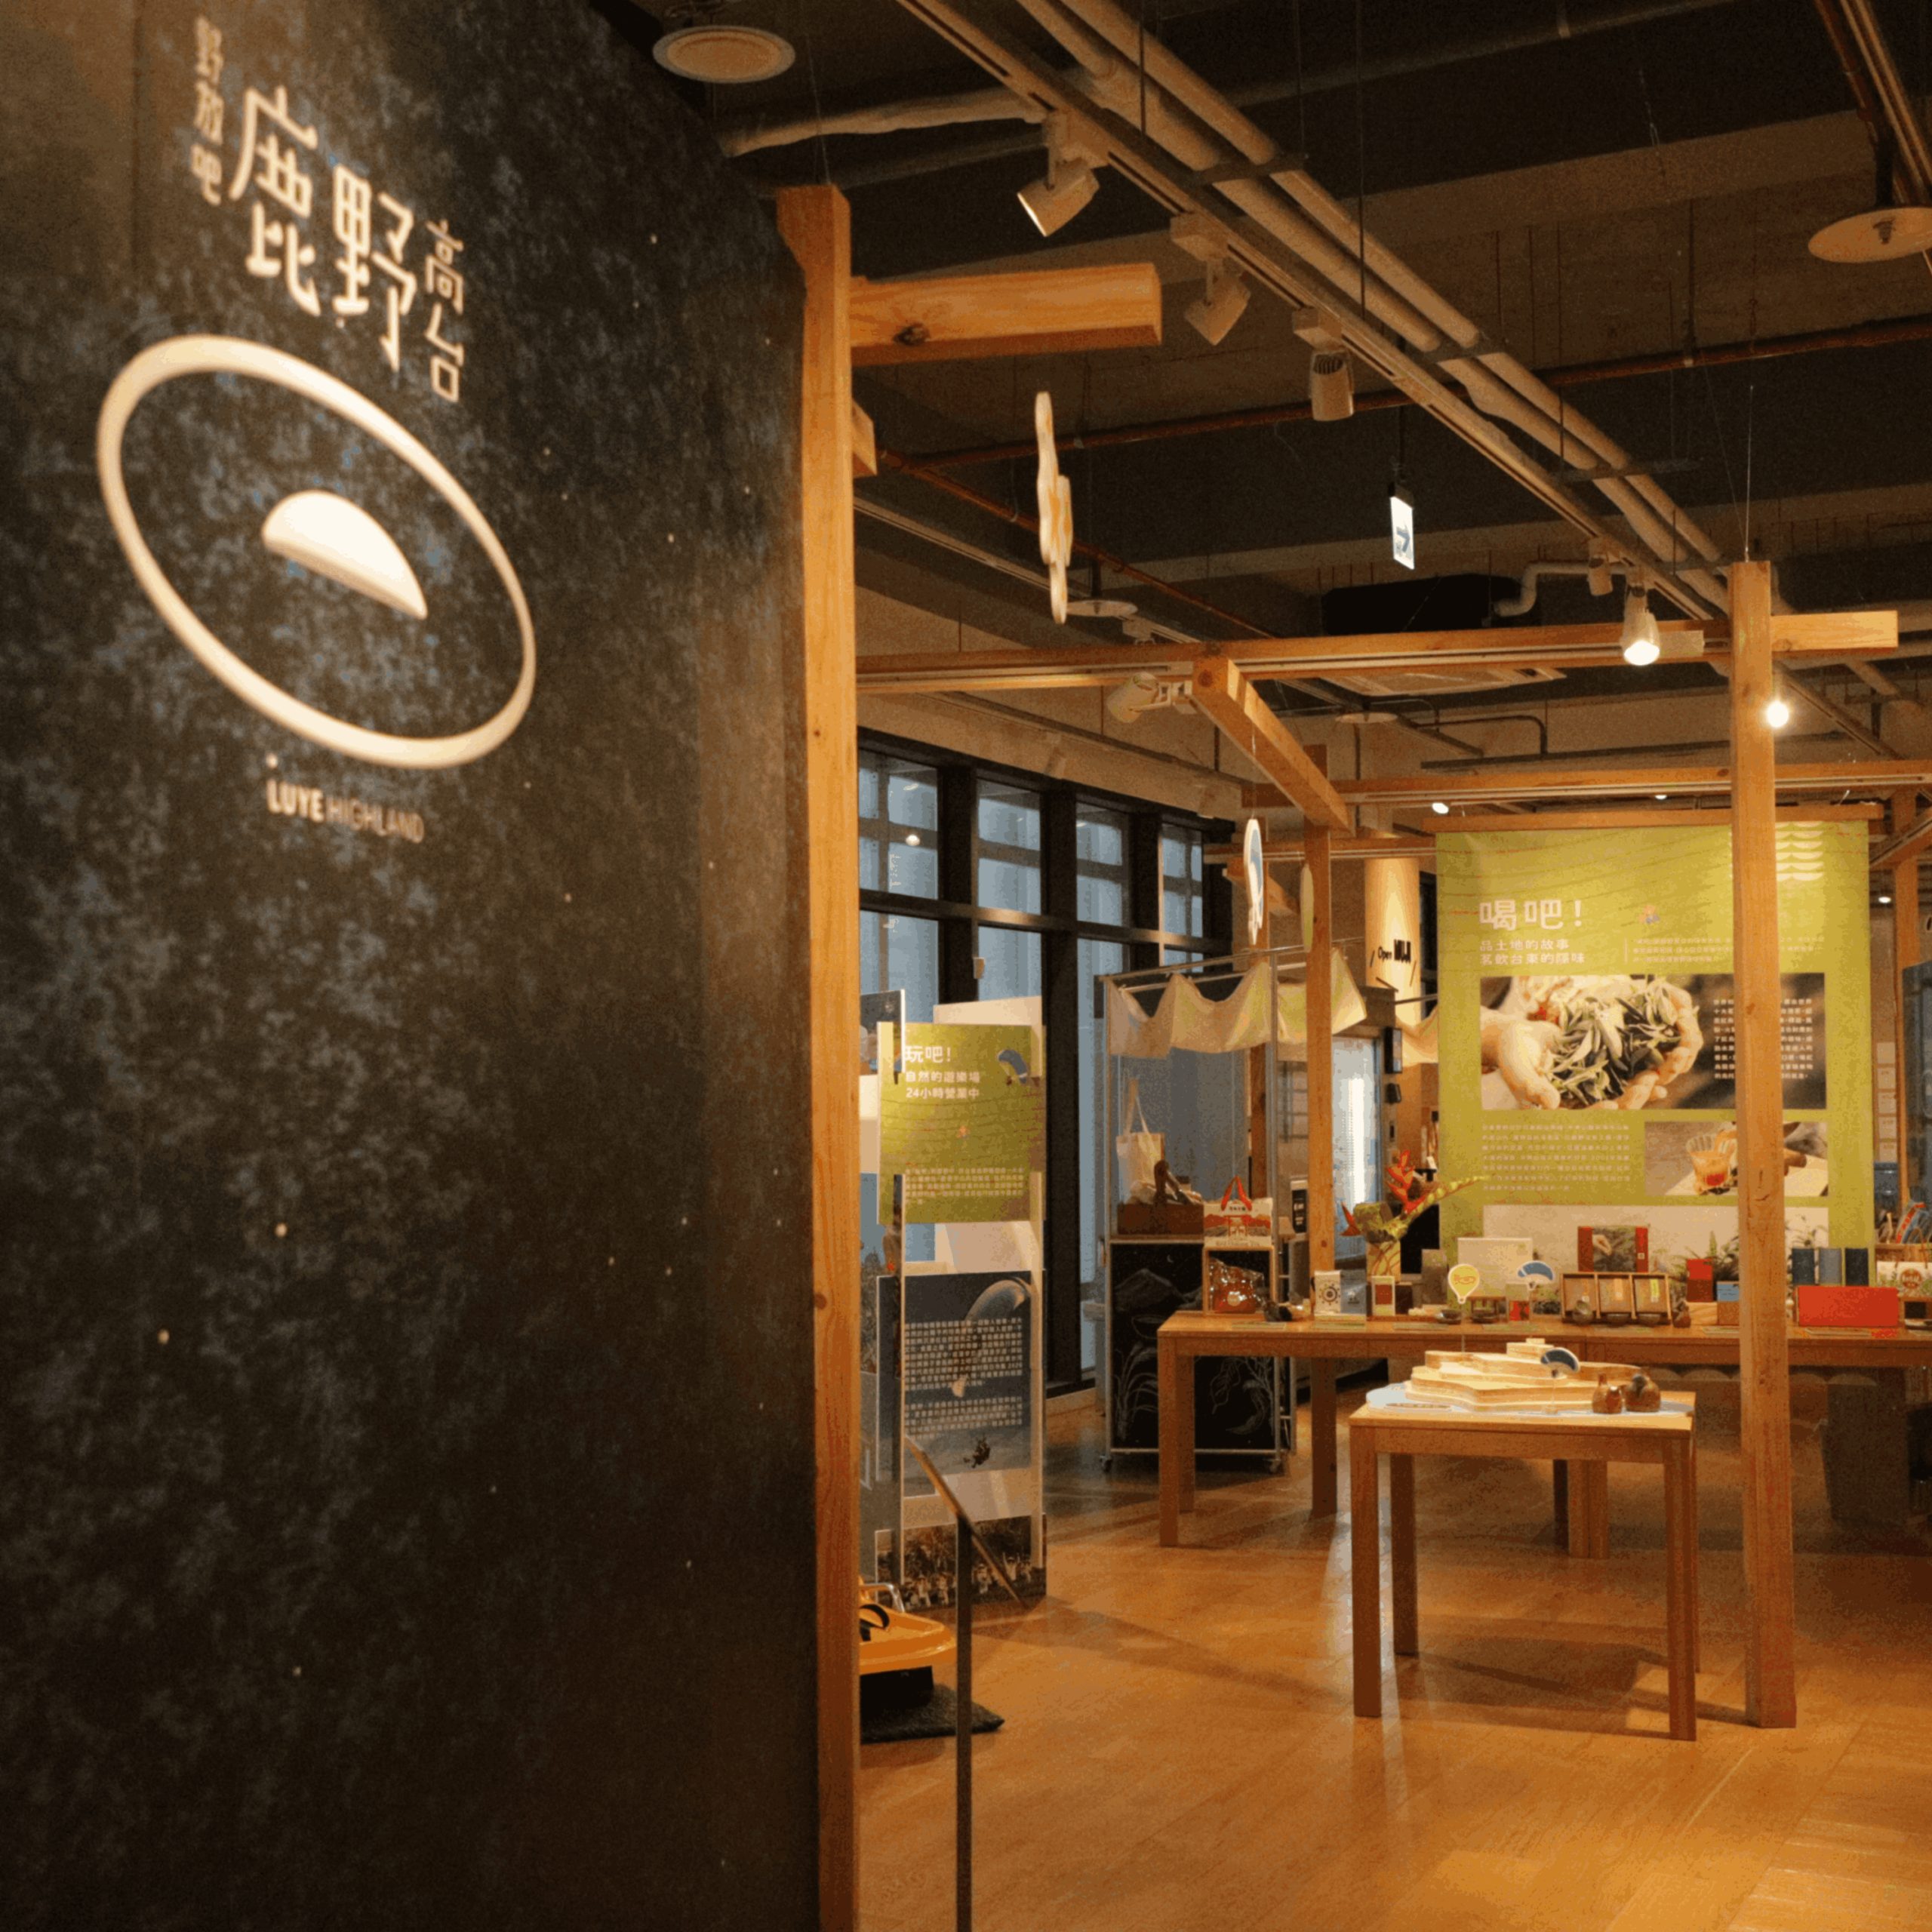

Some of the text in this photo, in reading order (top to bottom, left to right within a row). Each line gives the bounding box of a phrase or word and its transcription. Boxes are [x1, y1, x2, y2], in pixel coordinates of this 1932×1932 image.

[229, 85, 417, 372] 鹿野
[424, 220, 465, 404] 高台
[266, 779, 425, 844] LUYE HIGHLAND
[1394, 939, 1411, 964] MUJI
[1480, 939, 1570, 952] 品土地的故事
[906, 1087, 980, 1100] 24小時營業中
